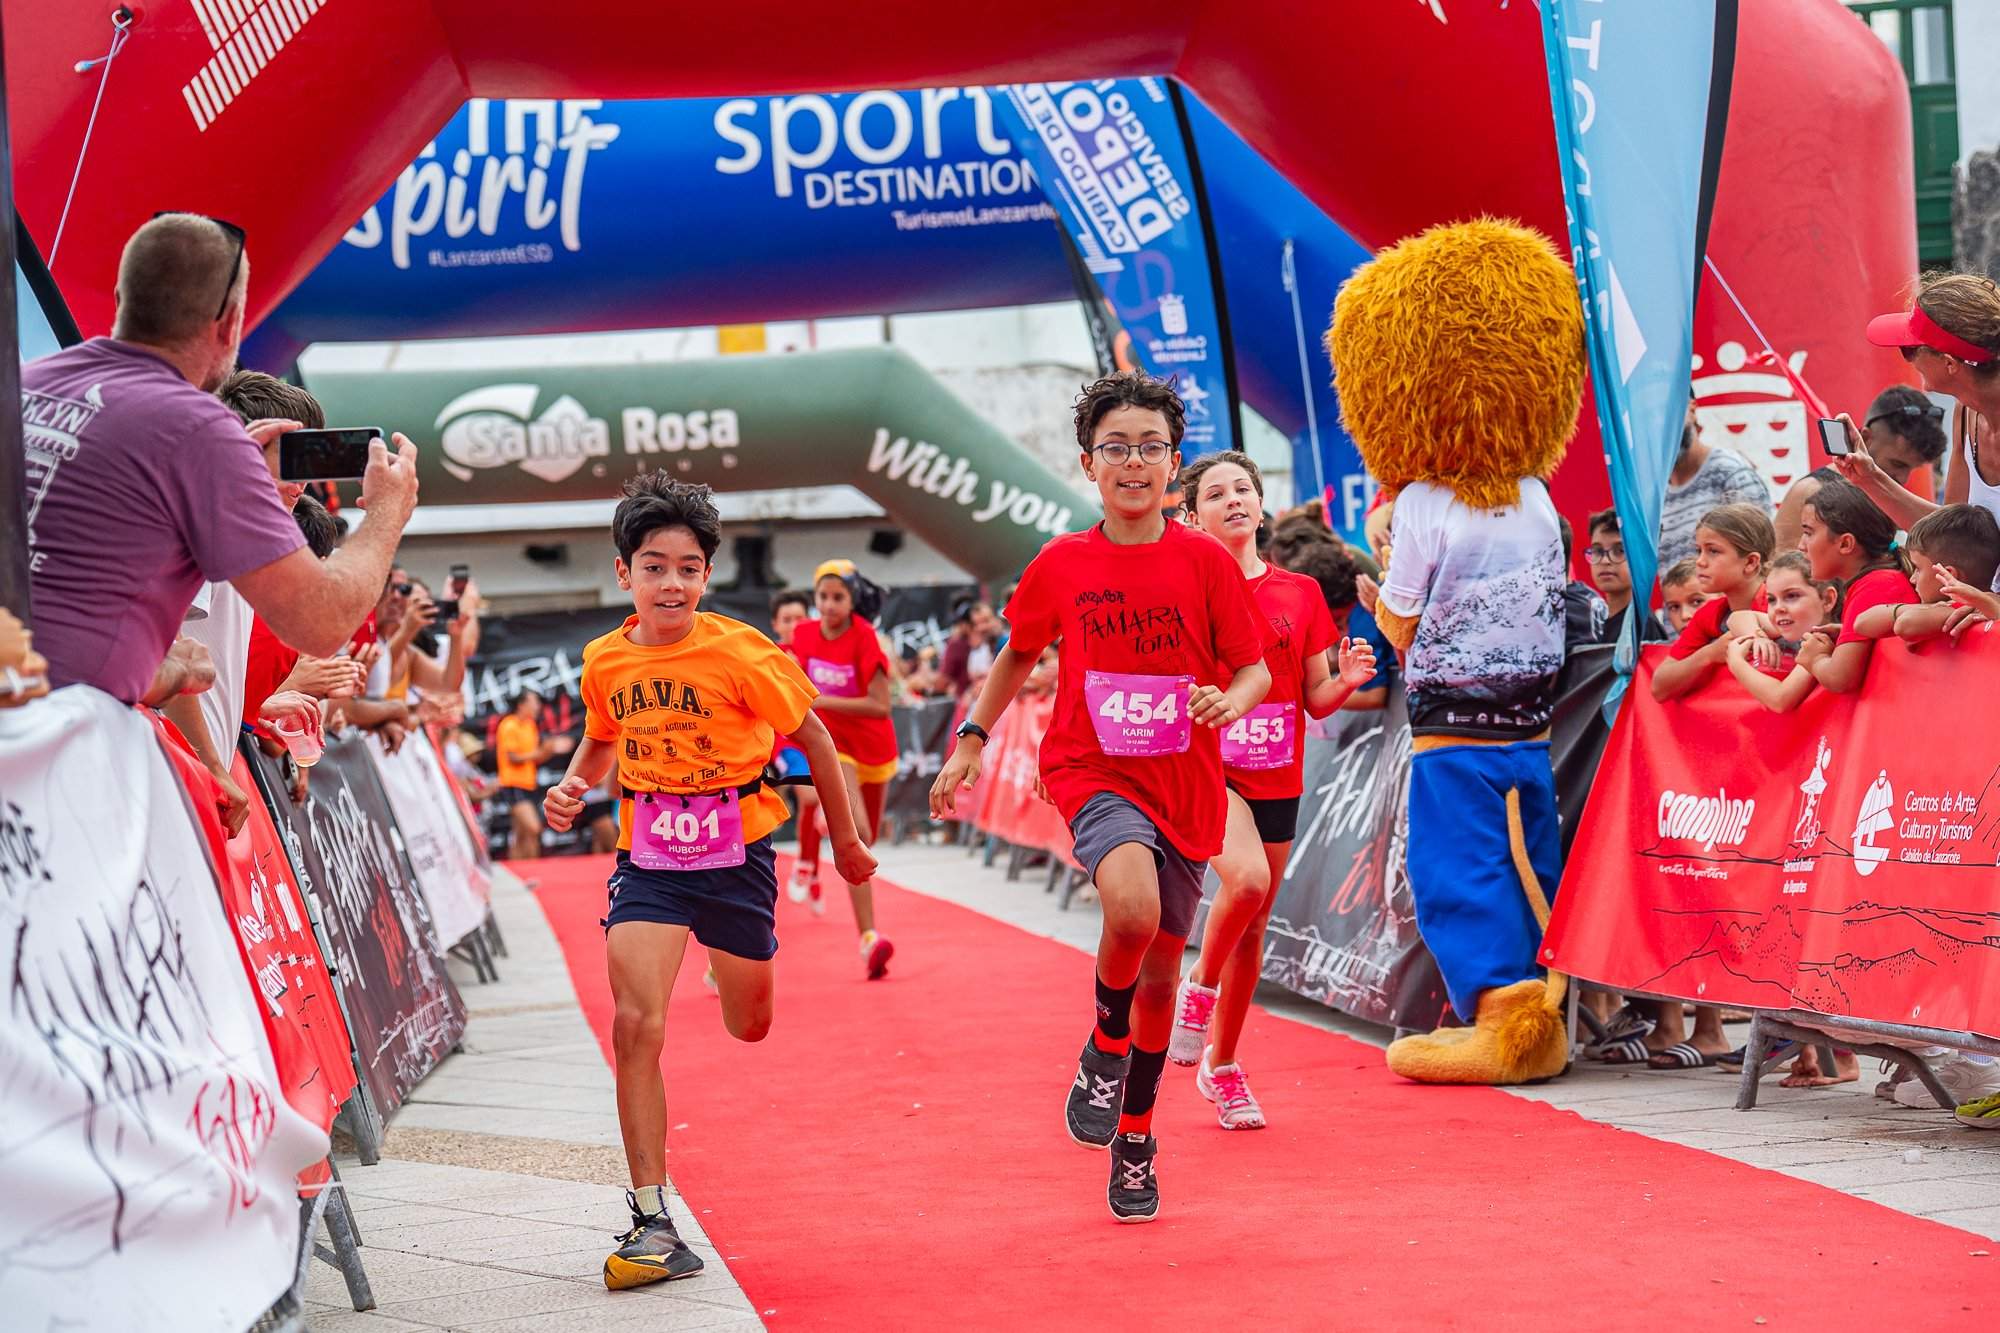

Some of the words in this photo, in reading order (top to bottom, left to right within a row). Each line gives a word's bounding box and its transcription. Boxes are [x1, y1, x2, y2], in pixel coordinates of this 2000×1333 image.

[713, 88, 1011, 198] sport
[465, 413, 611, 461] Santa
[620, 406, 740, 454] Rosa
[867, 426, 980, 506] With
[971, 479, 1073, 537] you
[1078, 602, 1185, 653] FAMARA
[609, 677, 713, 722] U.A.V.A.
[1099, 690, 1179, 725] 454
[1122, 726, 1156, 737] KARIM
[1226, 716, 1285, 745] 453
[1247, 746, 1269, 755] ALMA
[681, 771, 695, 785] el
[1904, 790, 1940, 812] Centros
[1941, 790, 1953, 812] de
[1953, 790, 1978, 815] Arte,
[650, 808, 720, 843] 401
[1899, 818, 1931, 840] Cultura
[1929, 826, 1938, 845] y
[1938, 817, 1973, 841] Turismo
[668, 844, 708, 854] HUBOSS
[1900, 847, 1923, 862] Cabildo
[1923, 848, 1931, 863] de
[1931, 849, 1961, 864] Lanzarote
